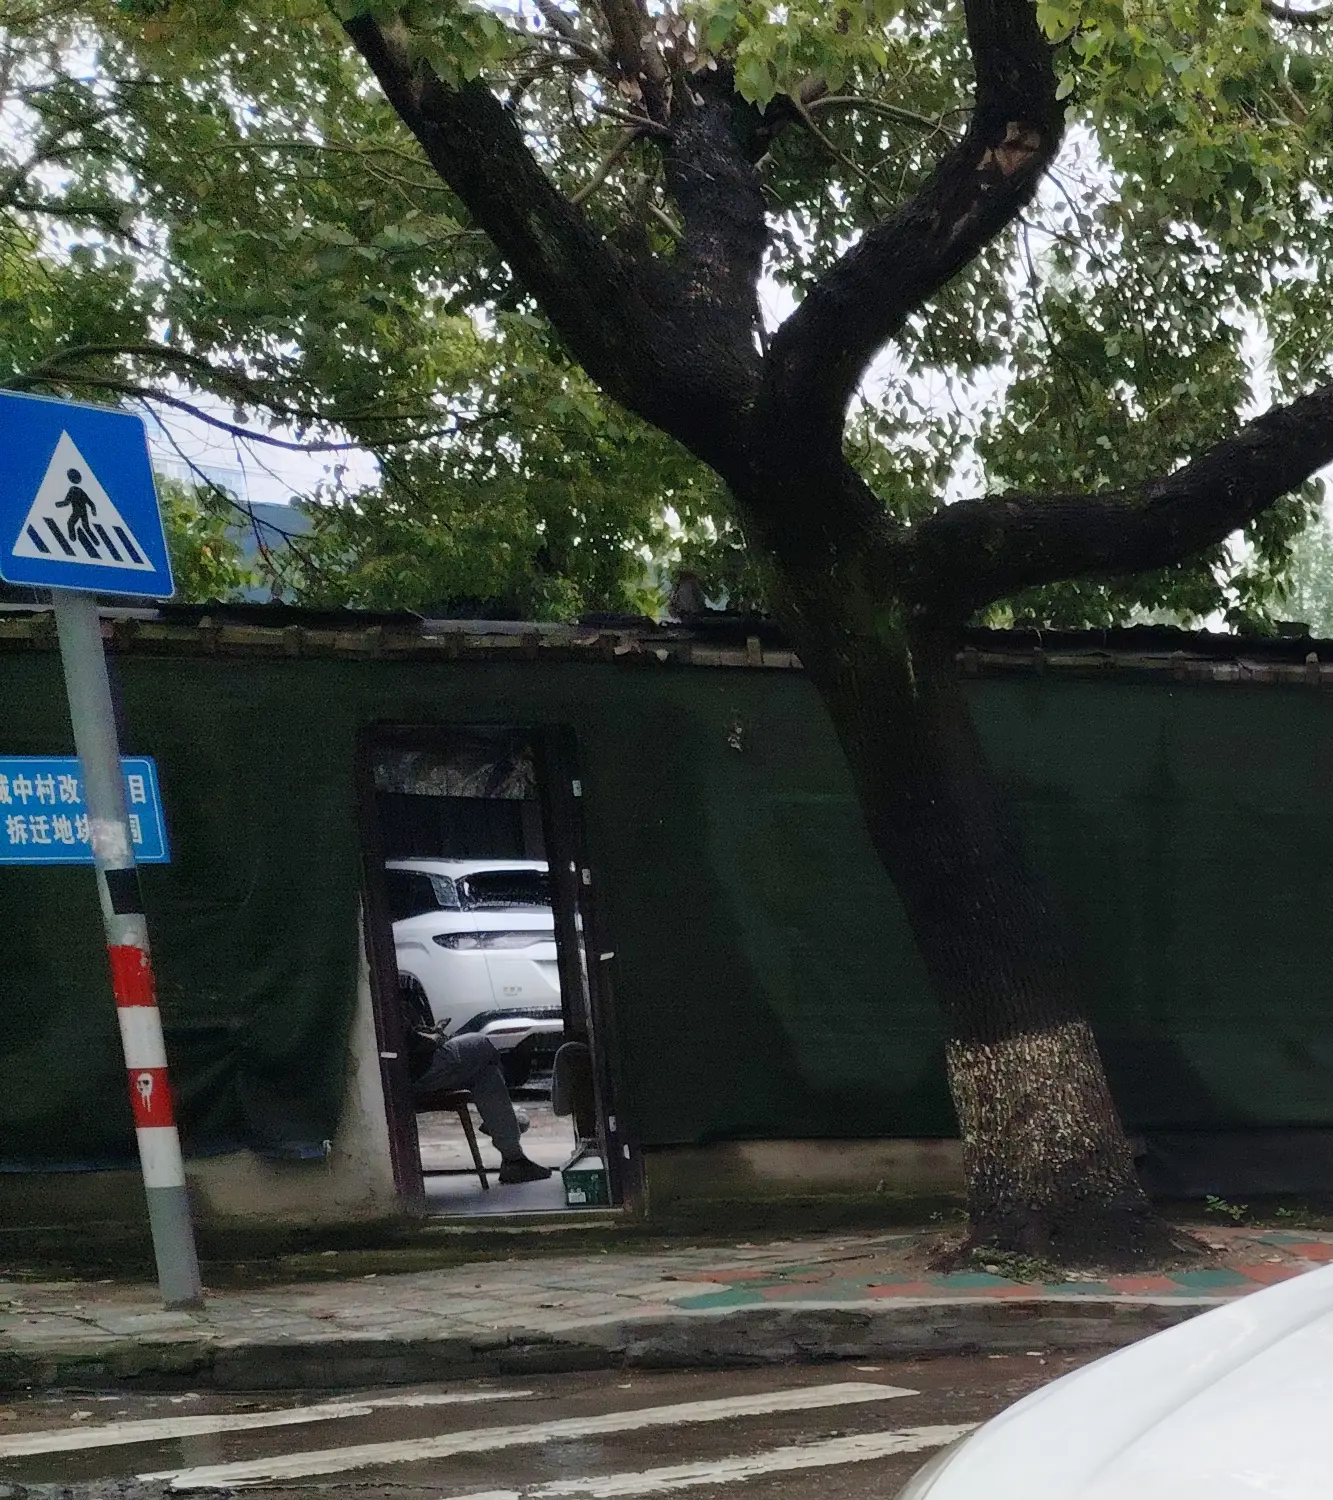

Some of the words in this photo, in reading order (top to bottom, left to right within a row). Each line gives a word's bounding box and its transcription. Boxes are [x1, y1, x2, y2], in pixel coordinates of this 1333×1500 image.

[0, 774, 146, 804] 城中村改目
[5, 814, 142, 844] 拆迁地块围
